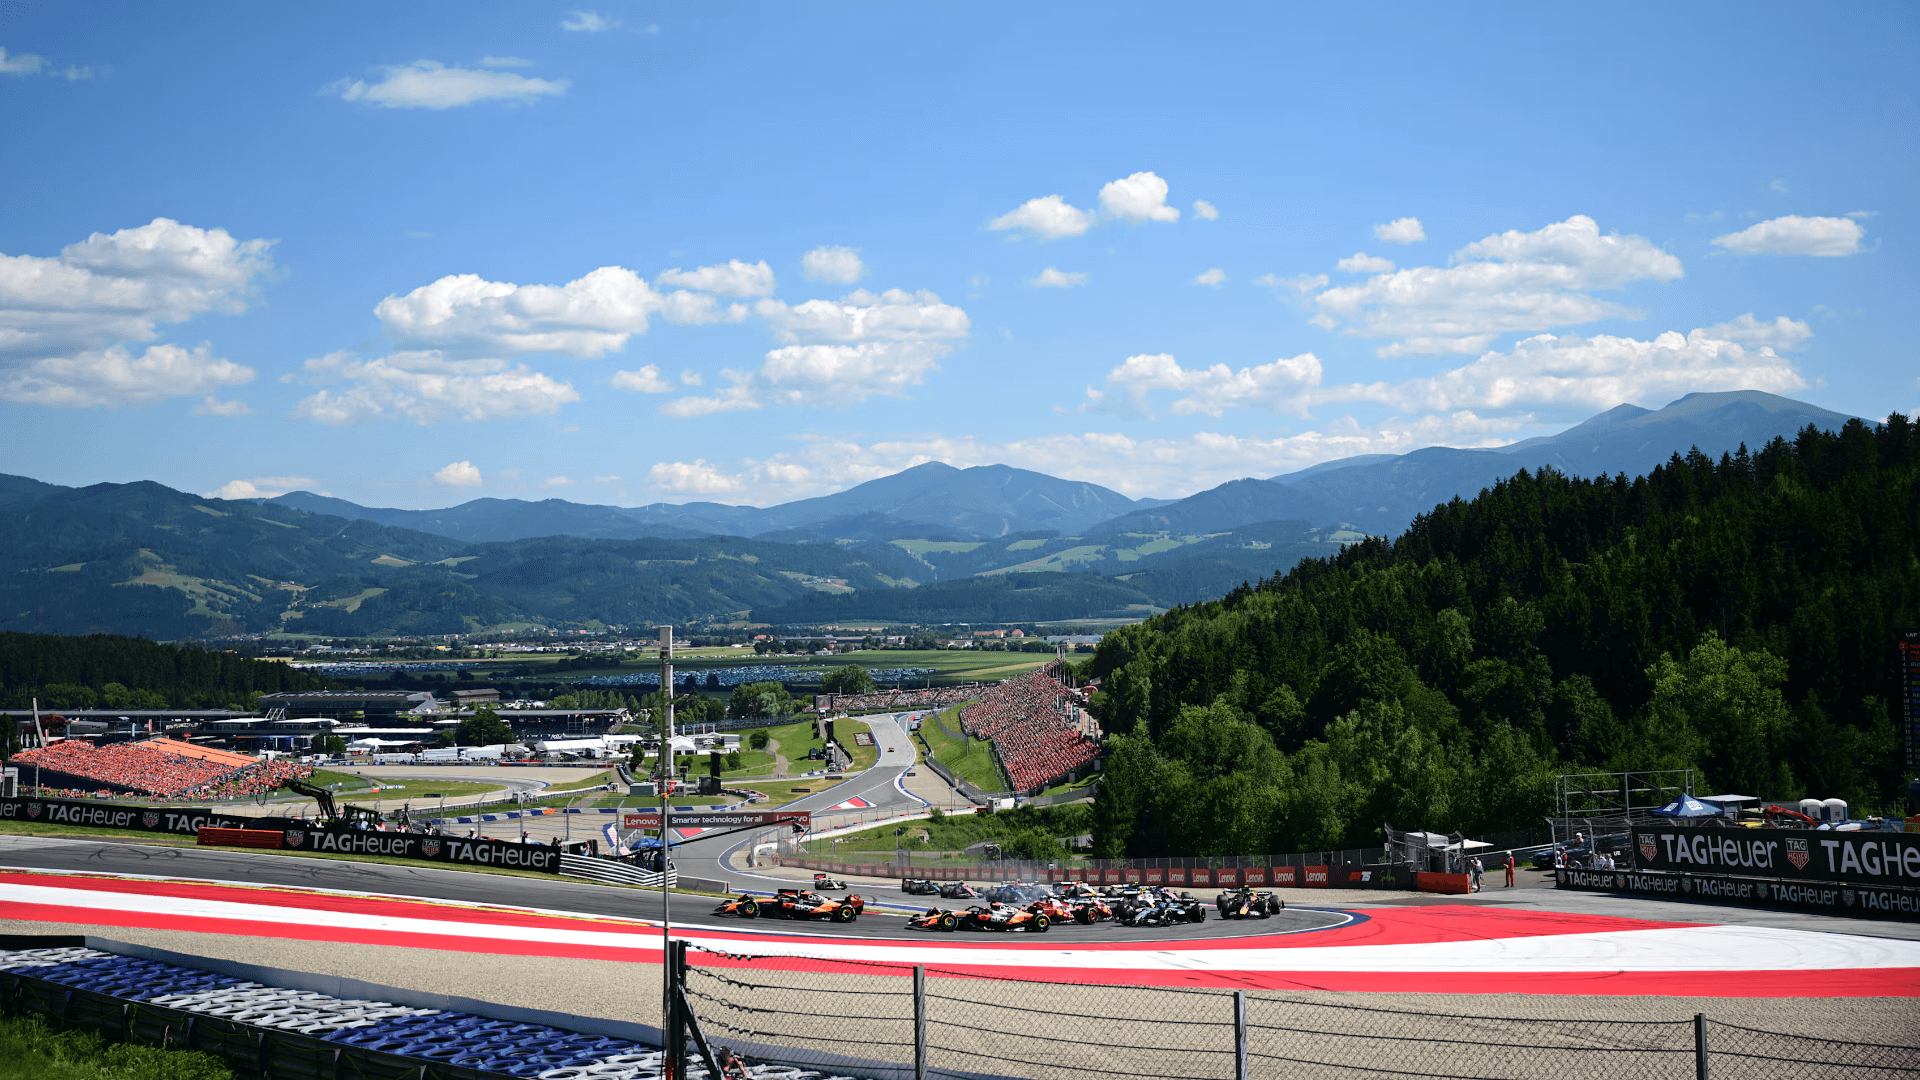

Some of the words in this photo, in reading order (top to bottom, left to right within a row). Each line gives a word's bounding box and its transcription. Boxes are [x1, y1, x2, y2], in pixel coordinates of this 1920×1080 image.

[47, 804, 136, 827] TAGHeuer
[626, 818, 658, 826] Lenovo
[702, 816, 742, 824] technology
[310, 832, 414, 854] TAGHeuer
[1640, 836, 1655, 845] TAG
[1788, 840, 1806, 850] TAG
[446, 842, 556, 868] TAGHeuer
[1660, 834, 1778, 868] TAGHeuer
[1193, 873, 1210, 882] Lenovo
[1218, 873, 1236, 882] Lenovo
[1246, 872, 1264, 882] Lenovo
[1274, 872, 1294, 882] Lenovo
[1306, 870, 1326, 882] Lenovo
[1567, 871, 1614, 888] TAGHeuer
[1627, 875, 1678, 892] TAGHeuer
[1694, 879, 1754, 898] TAGHeuer
[1770, 884, 1838, 906] TAGHeuer
